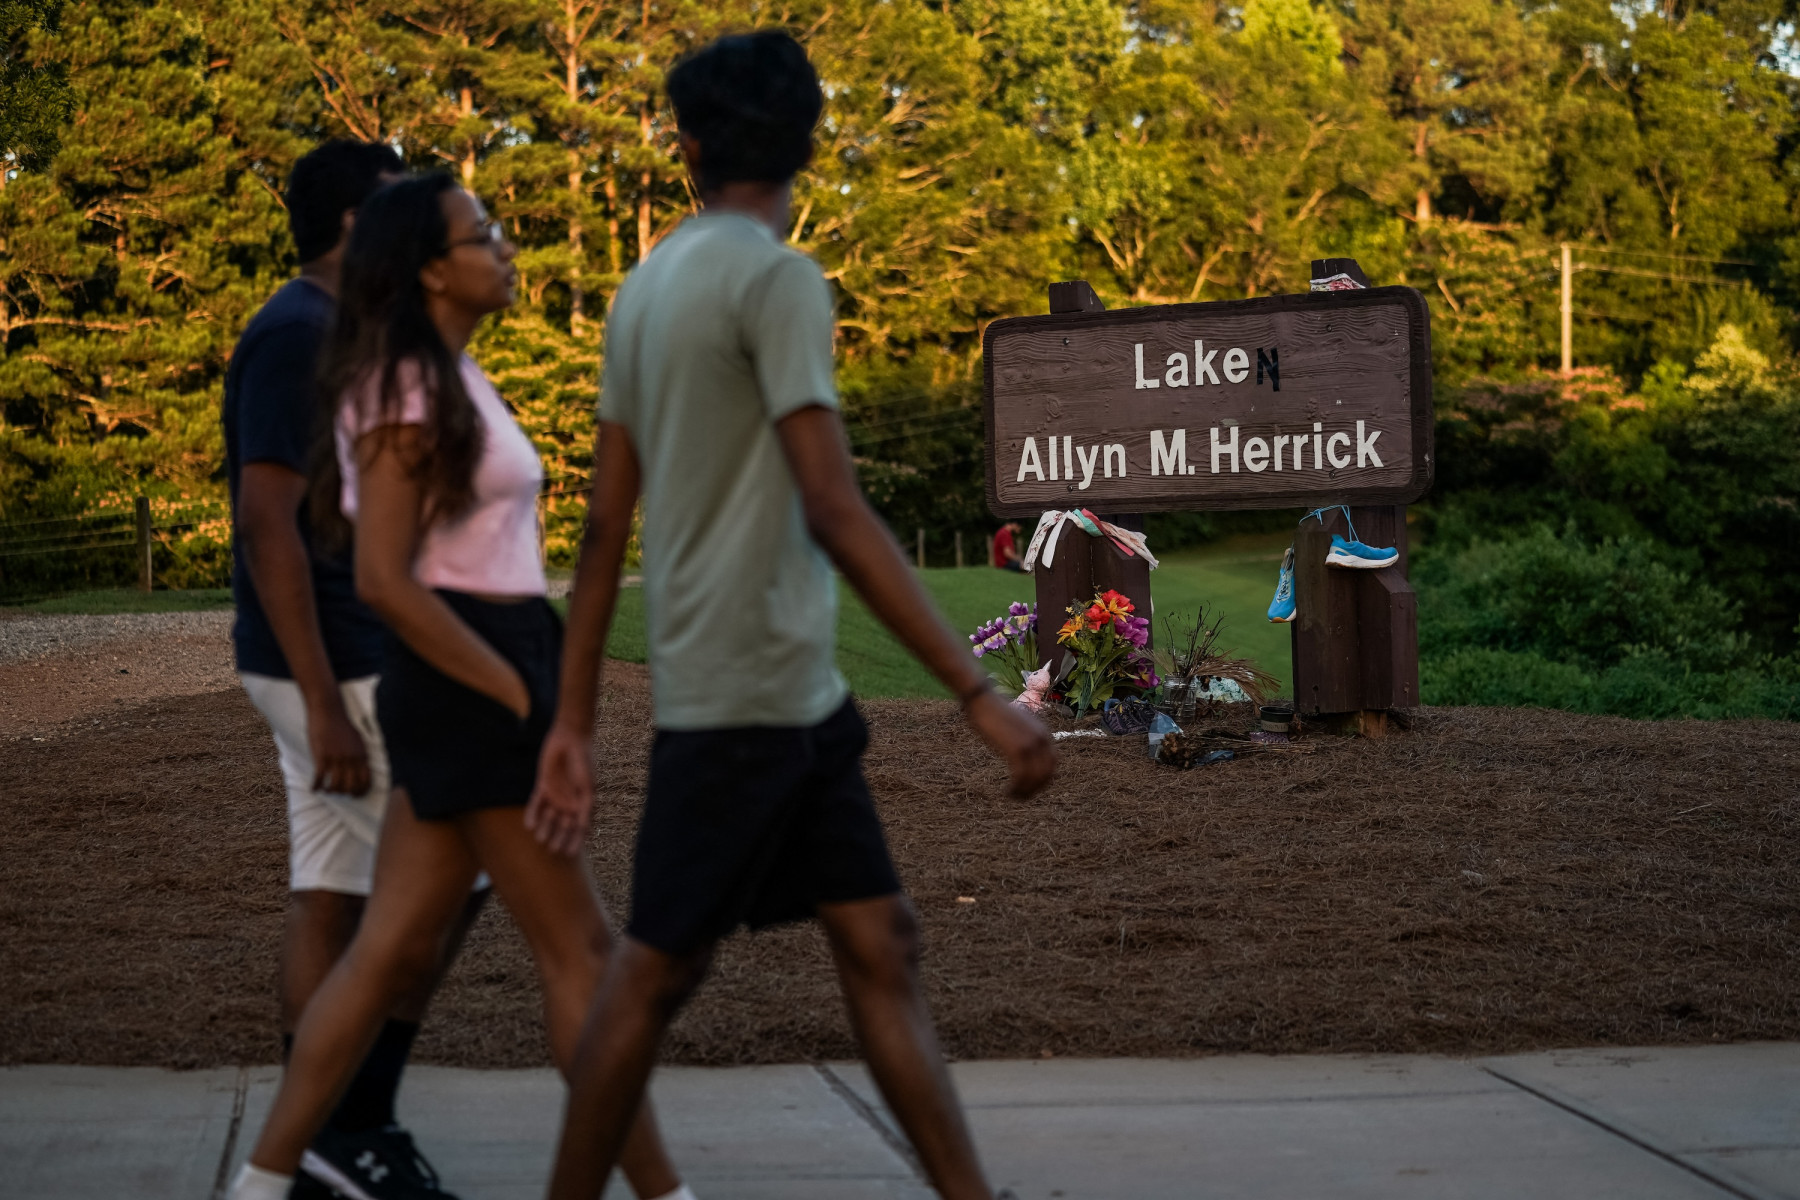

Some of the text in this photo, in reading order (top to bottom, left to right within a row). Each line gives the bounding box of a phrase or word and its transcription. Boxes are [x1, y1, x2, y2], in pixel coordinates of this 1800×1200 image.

[1135, 339, 1250, 389] Lake
[1016, 420, 1384, 490] Allyn M. Herrick
